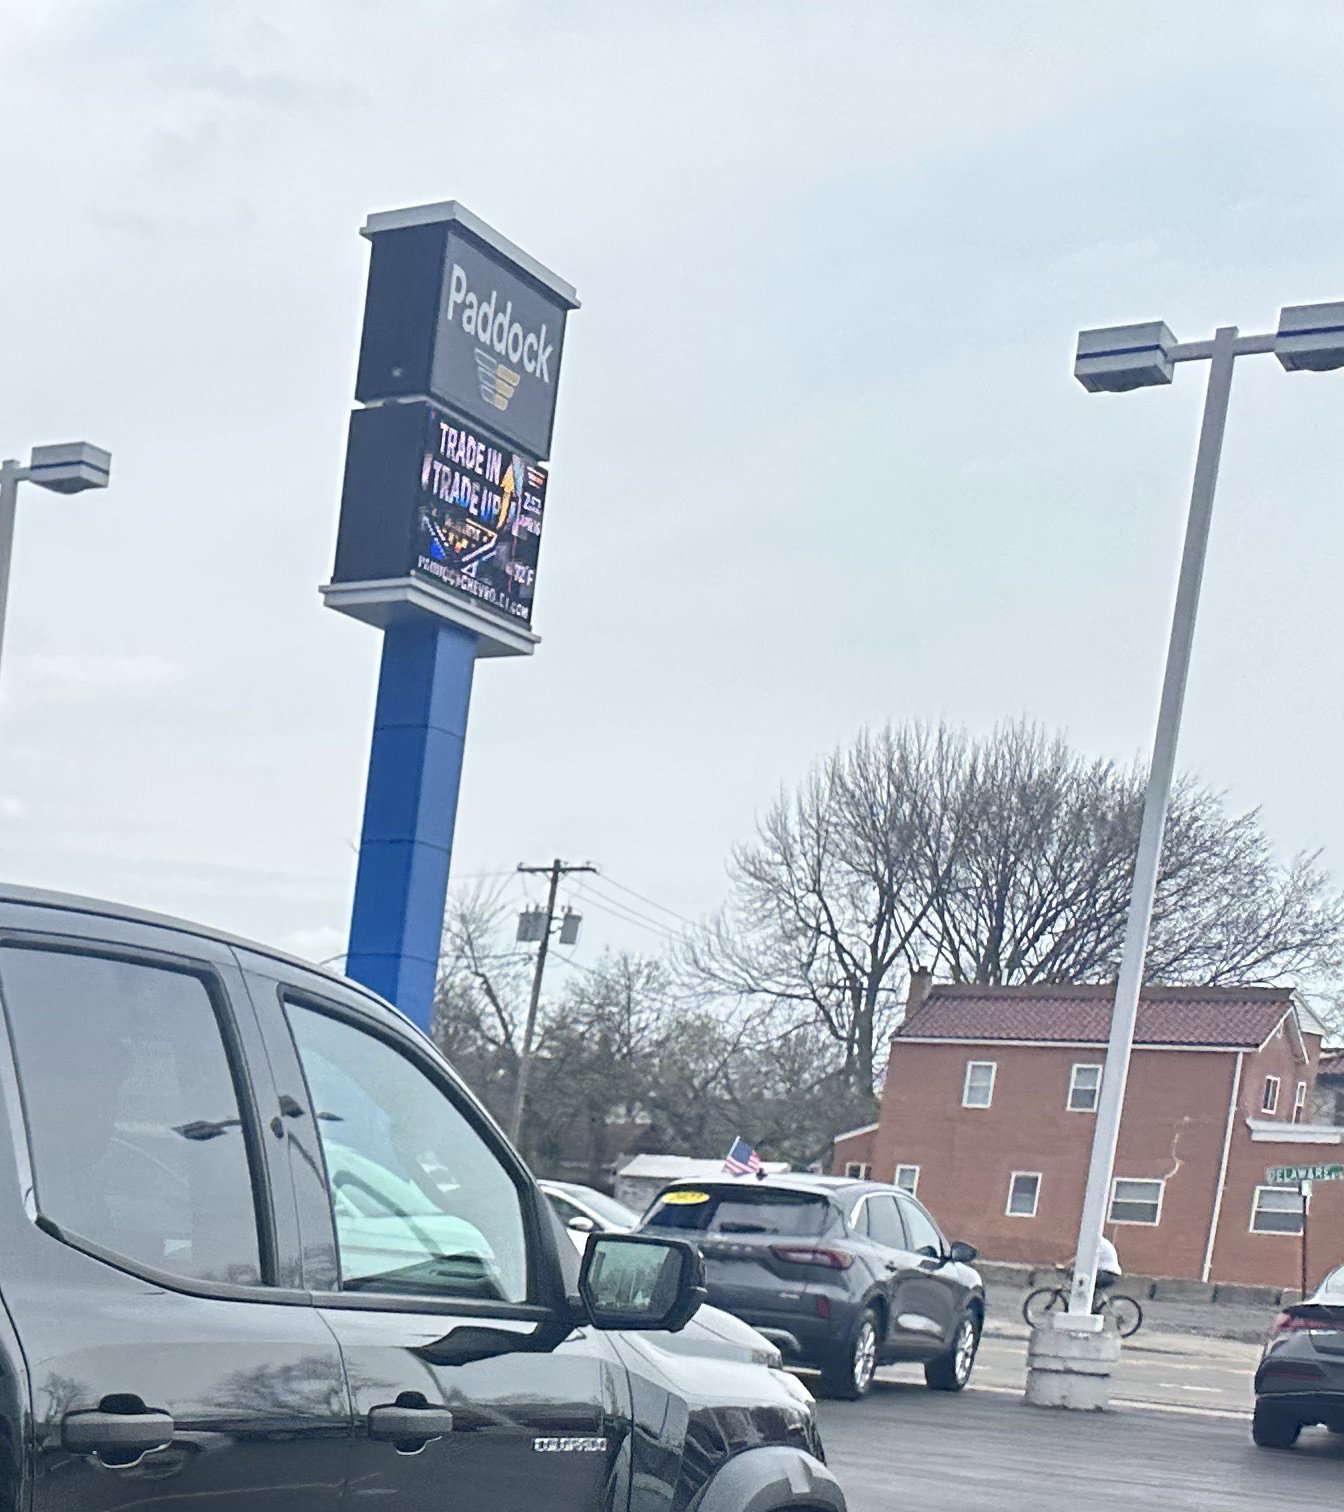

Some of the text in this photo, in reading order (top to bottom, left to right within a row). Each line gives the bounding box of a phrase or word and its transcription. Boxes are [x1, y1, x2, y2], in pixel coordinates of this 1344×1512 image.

[447, 263, 553, 384] Paddock
[440, 422, 502, 486] TRADE IN
[432, 460, 500, 521] TRADE UP
[1267, 1167, 1330, 1184] DELAWARE
[534, 1438, 607, 1452] COLORADO
